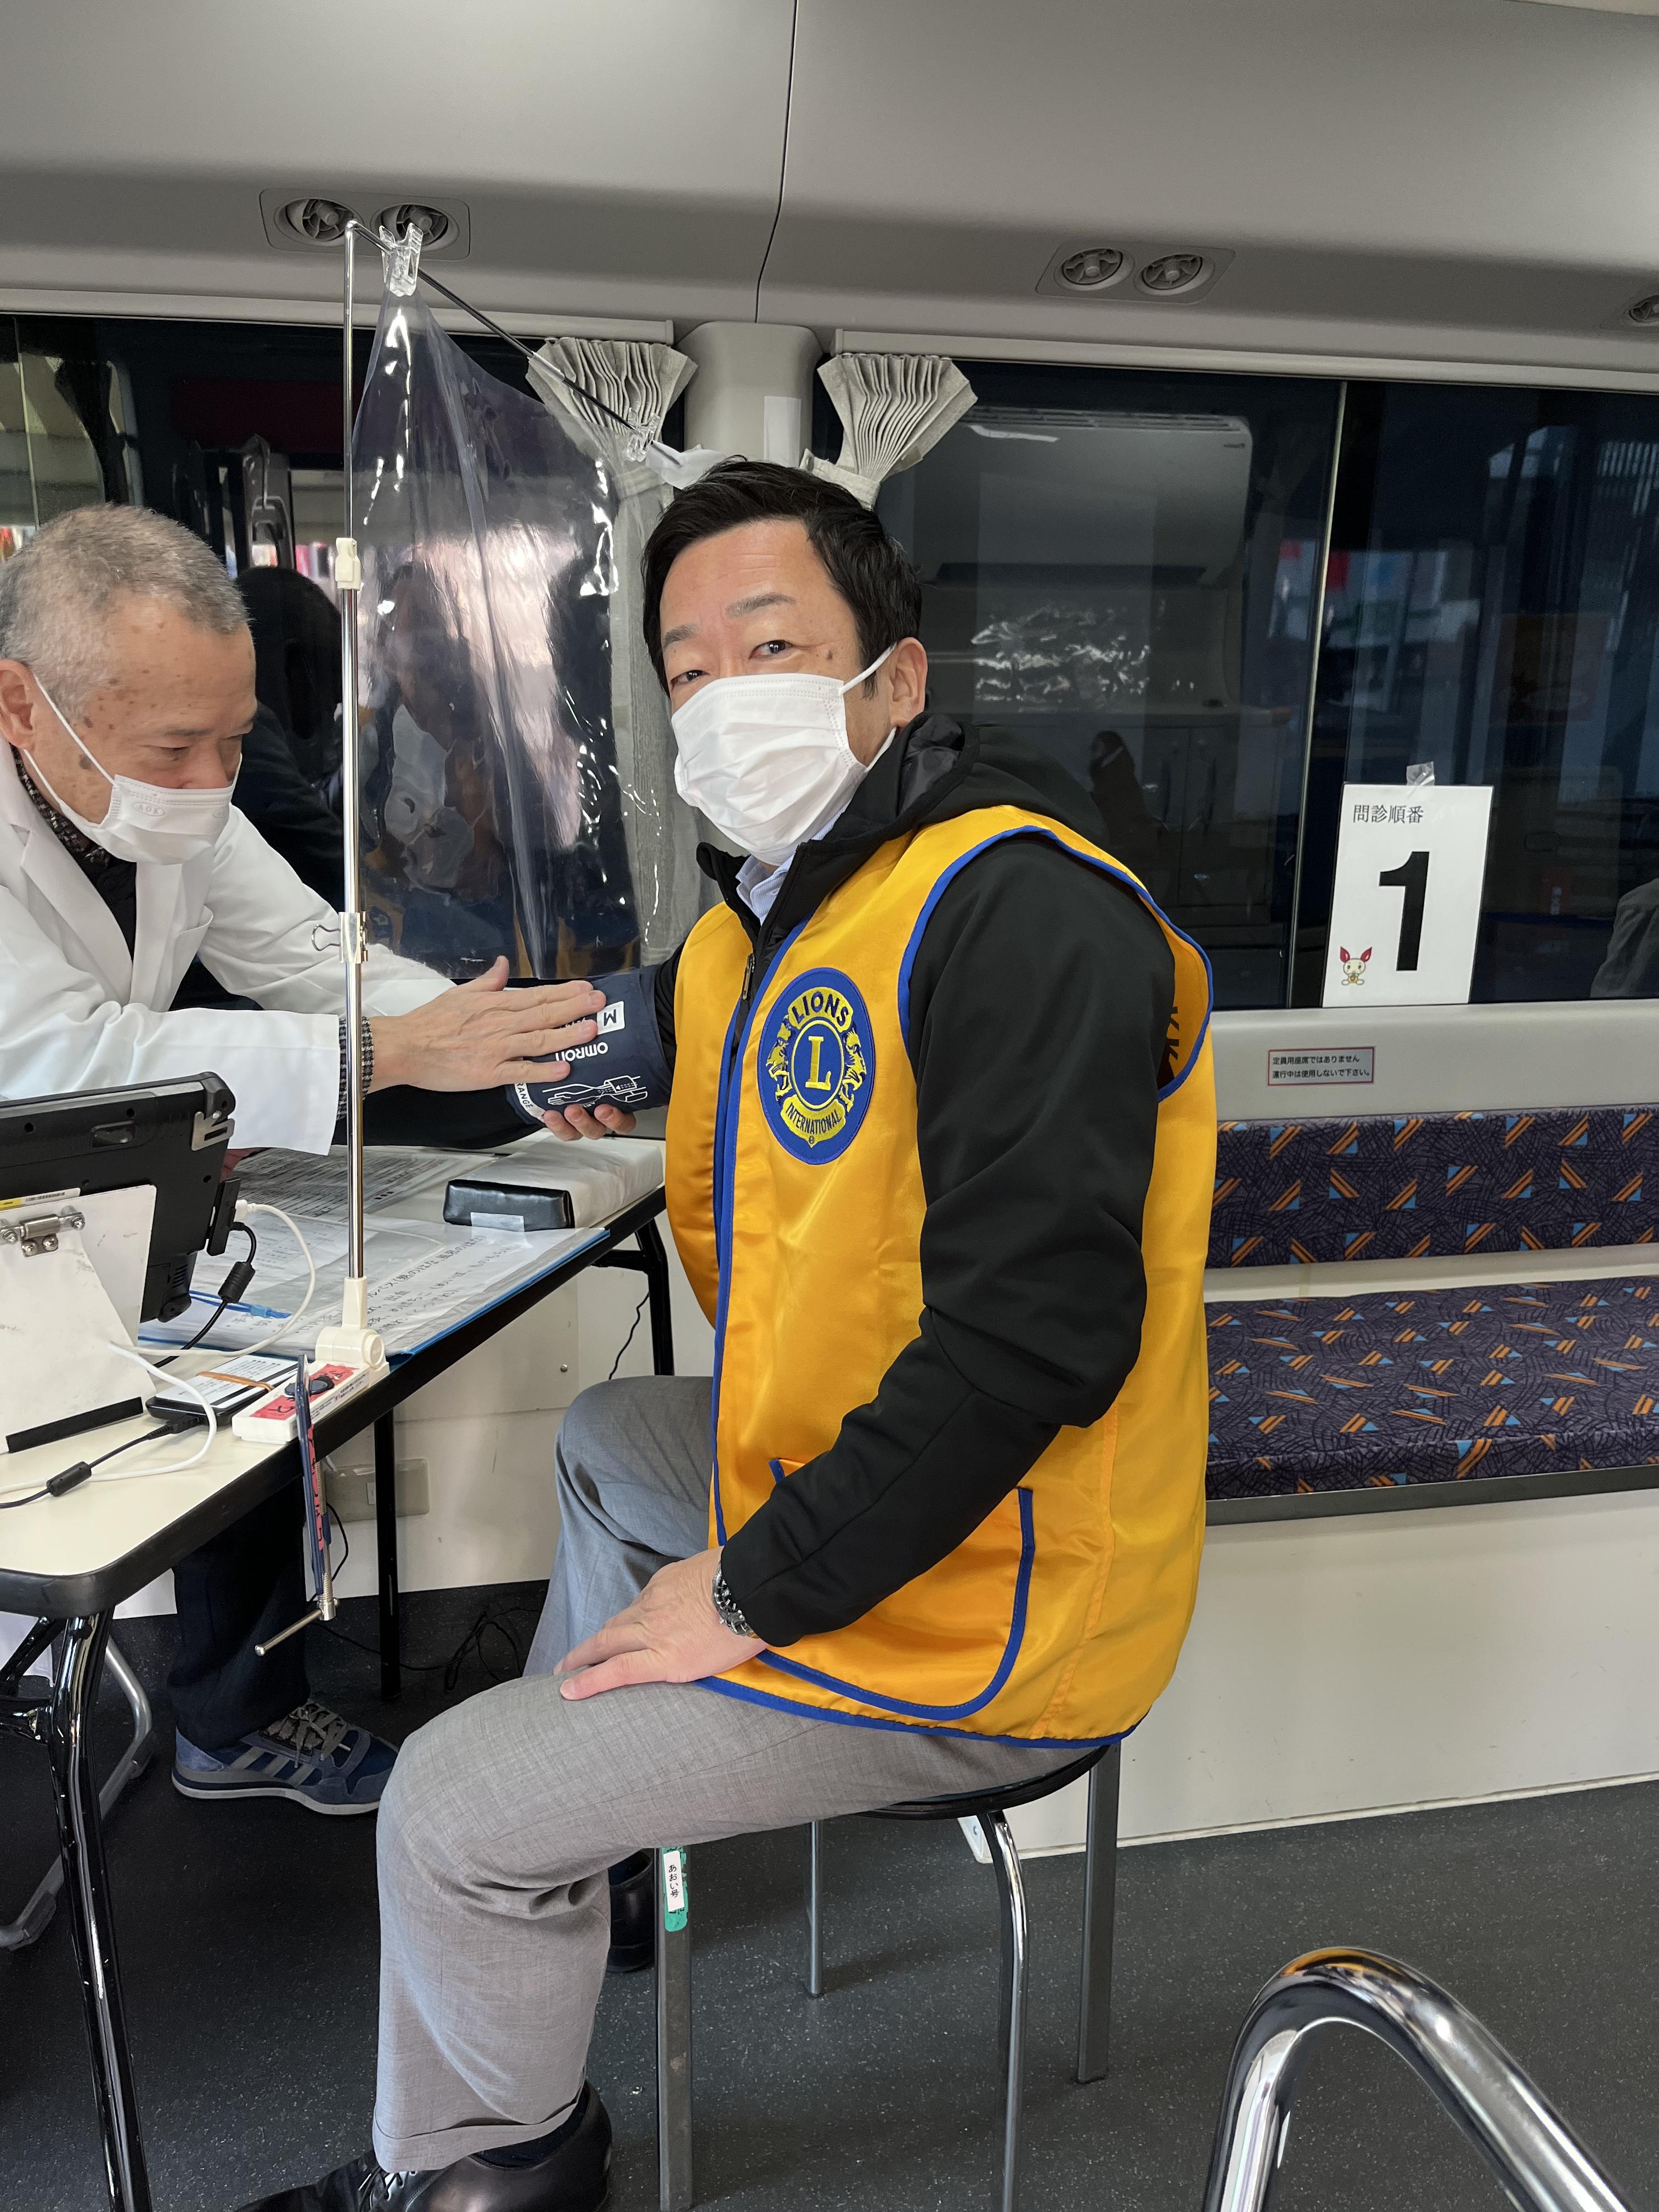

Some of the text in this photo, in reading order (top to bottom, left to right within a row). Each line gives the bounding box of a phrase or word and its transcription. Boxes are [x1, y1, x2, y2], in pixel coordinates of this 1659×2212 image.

[1353, 804, 1425, 824] 問診順番
[1379, 851, 1430, 972] 1
[603, 1008, 617, 1027] M
[791, 991, 850, 1027] LIONS
[805, 1035, 832, 1091] L
[1272, 1054, 1360, 1065] 定員用座席ではありません
[1272, 1068, 1370, 1079] 運行中は使用しないで下さい。
[785, 1102, 842, 1136] INTERNATIONAL
[668, 1864, 680, 1899] あおい号
